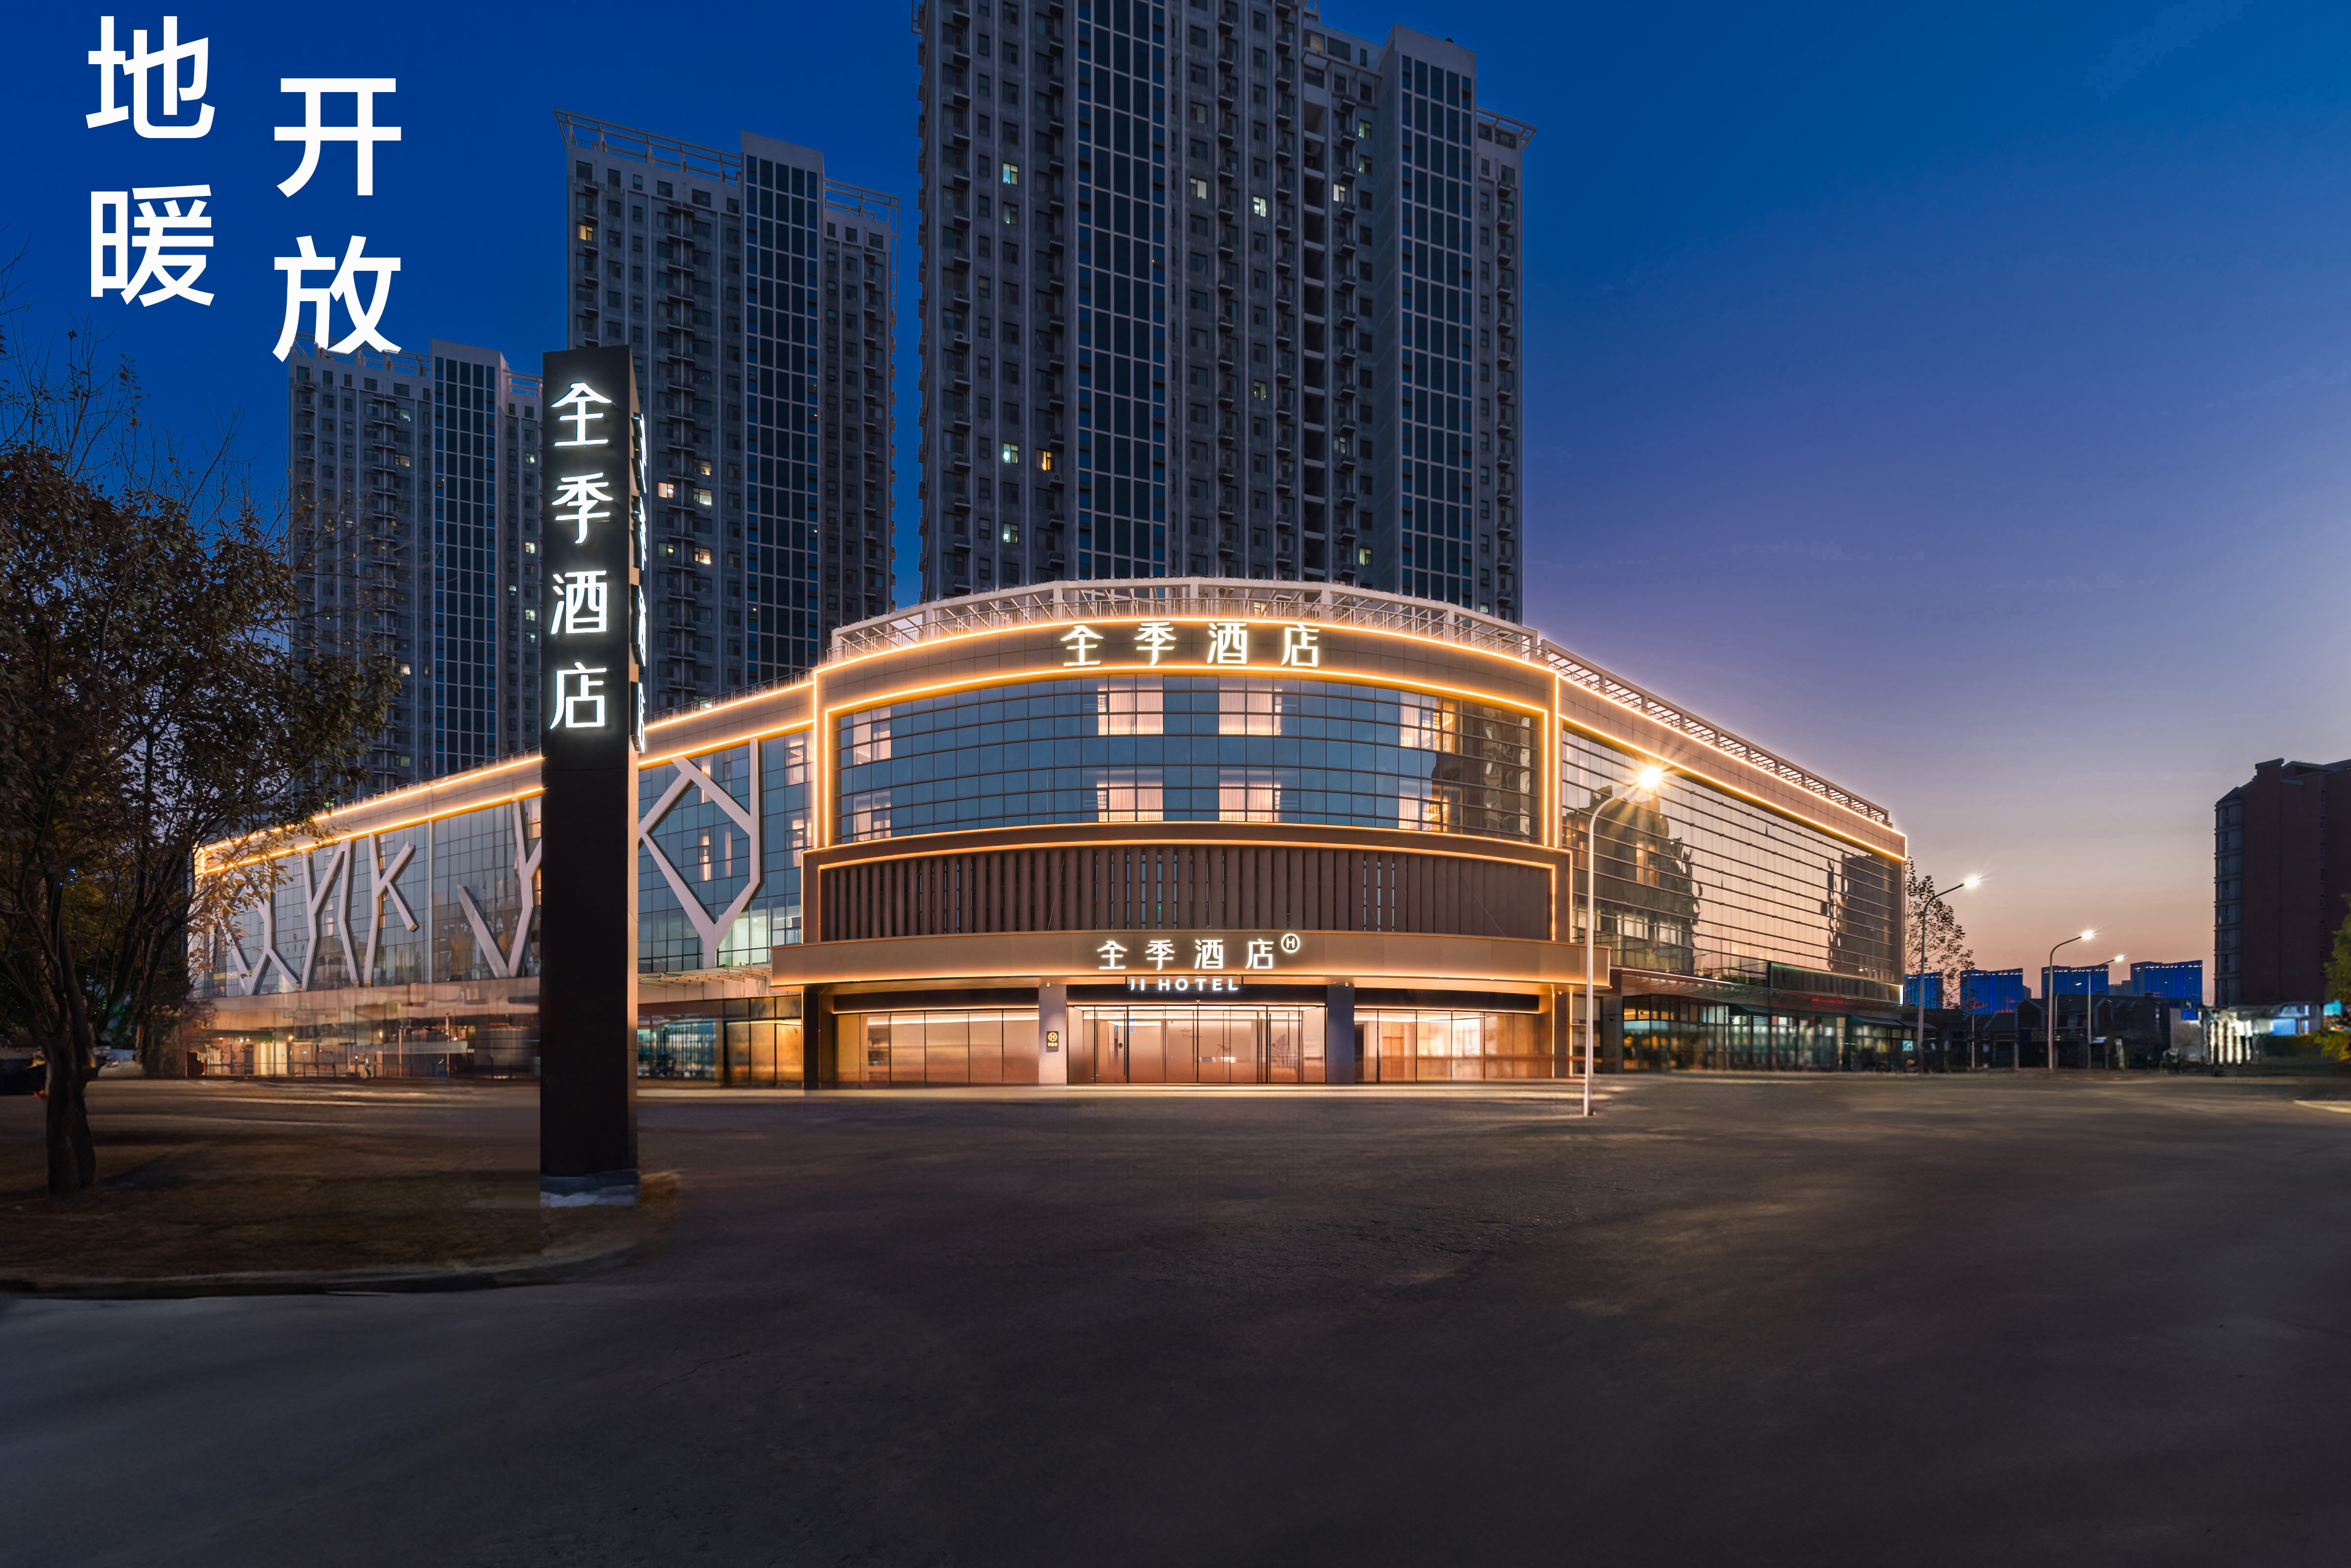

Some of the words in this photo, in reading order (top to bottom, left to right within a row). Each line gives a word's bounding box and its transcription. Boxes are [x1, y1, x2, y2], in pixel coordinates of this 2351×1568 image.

[550, 382, 614, 730] 全季酒店
[1060, 621, 1319, 667] 全季酒店
[1097, 938, 1274, 971] 全季酒店
[1130, 978, 1145, 991] JI
[1158, 978, 1239, 991] HOTEL
